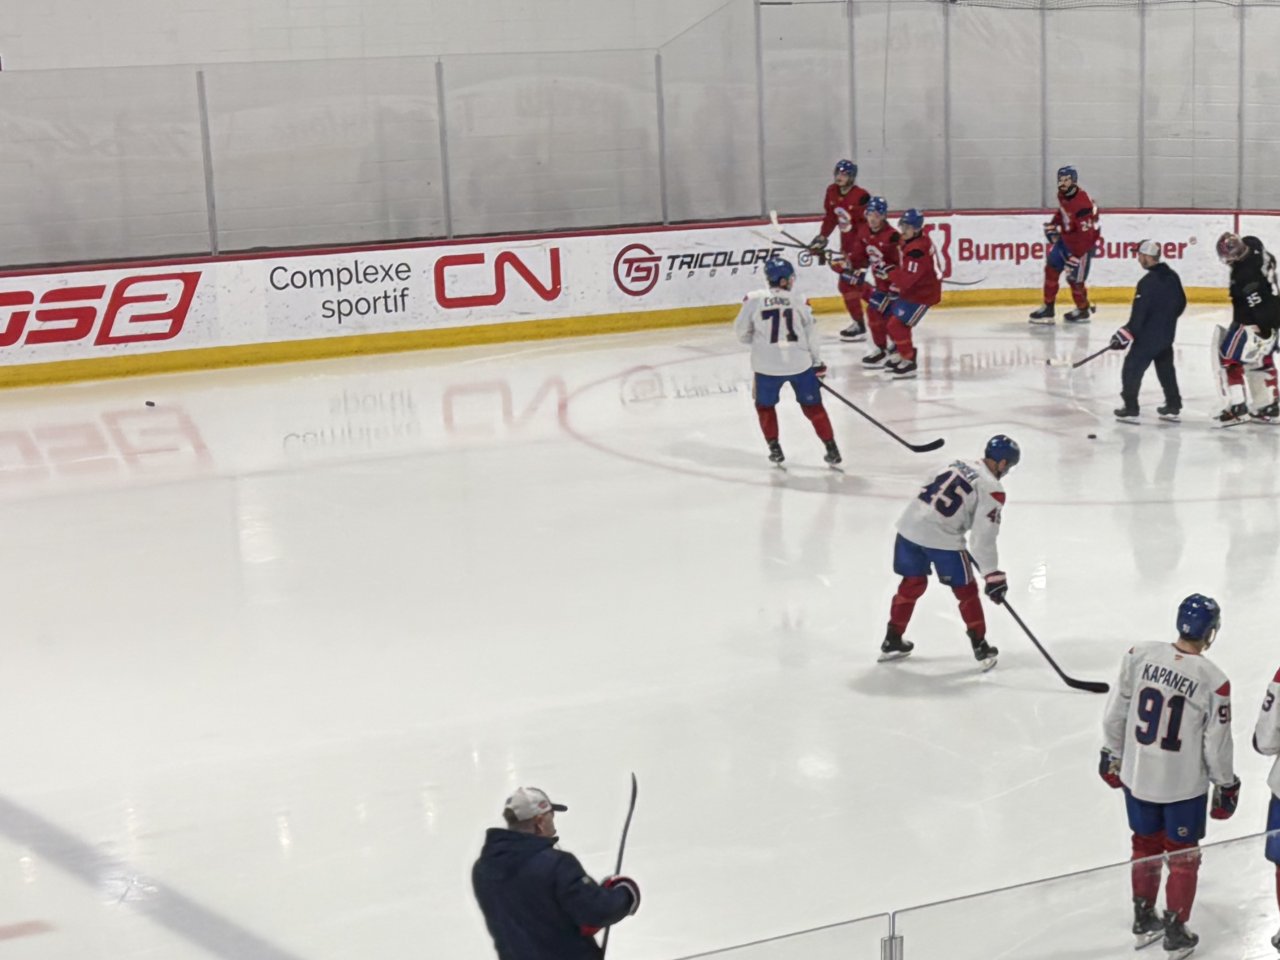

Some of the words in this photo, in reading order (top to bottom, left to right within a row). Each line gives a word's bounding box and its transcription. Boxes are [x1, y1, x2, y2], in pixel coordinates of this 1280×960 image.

[1093, 236, 1188, 260] Bumer
[269, 258, 411, 291] Complexe
[433, 246, 561, 310] CN
[321, 287, 410, 325] sportif
[760, 308, 799, 343] 71
[917, 470, 974, 518] 45
[1142, 663, 1199, 698] KAPANEN
[1135, 686, 1187, 753] 91
